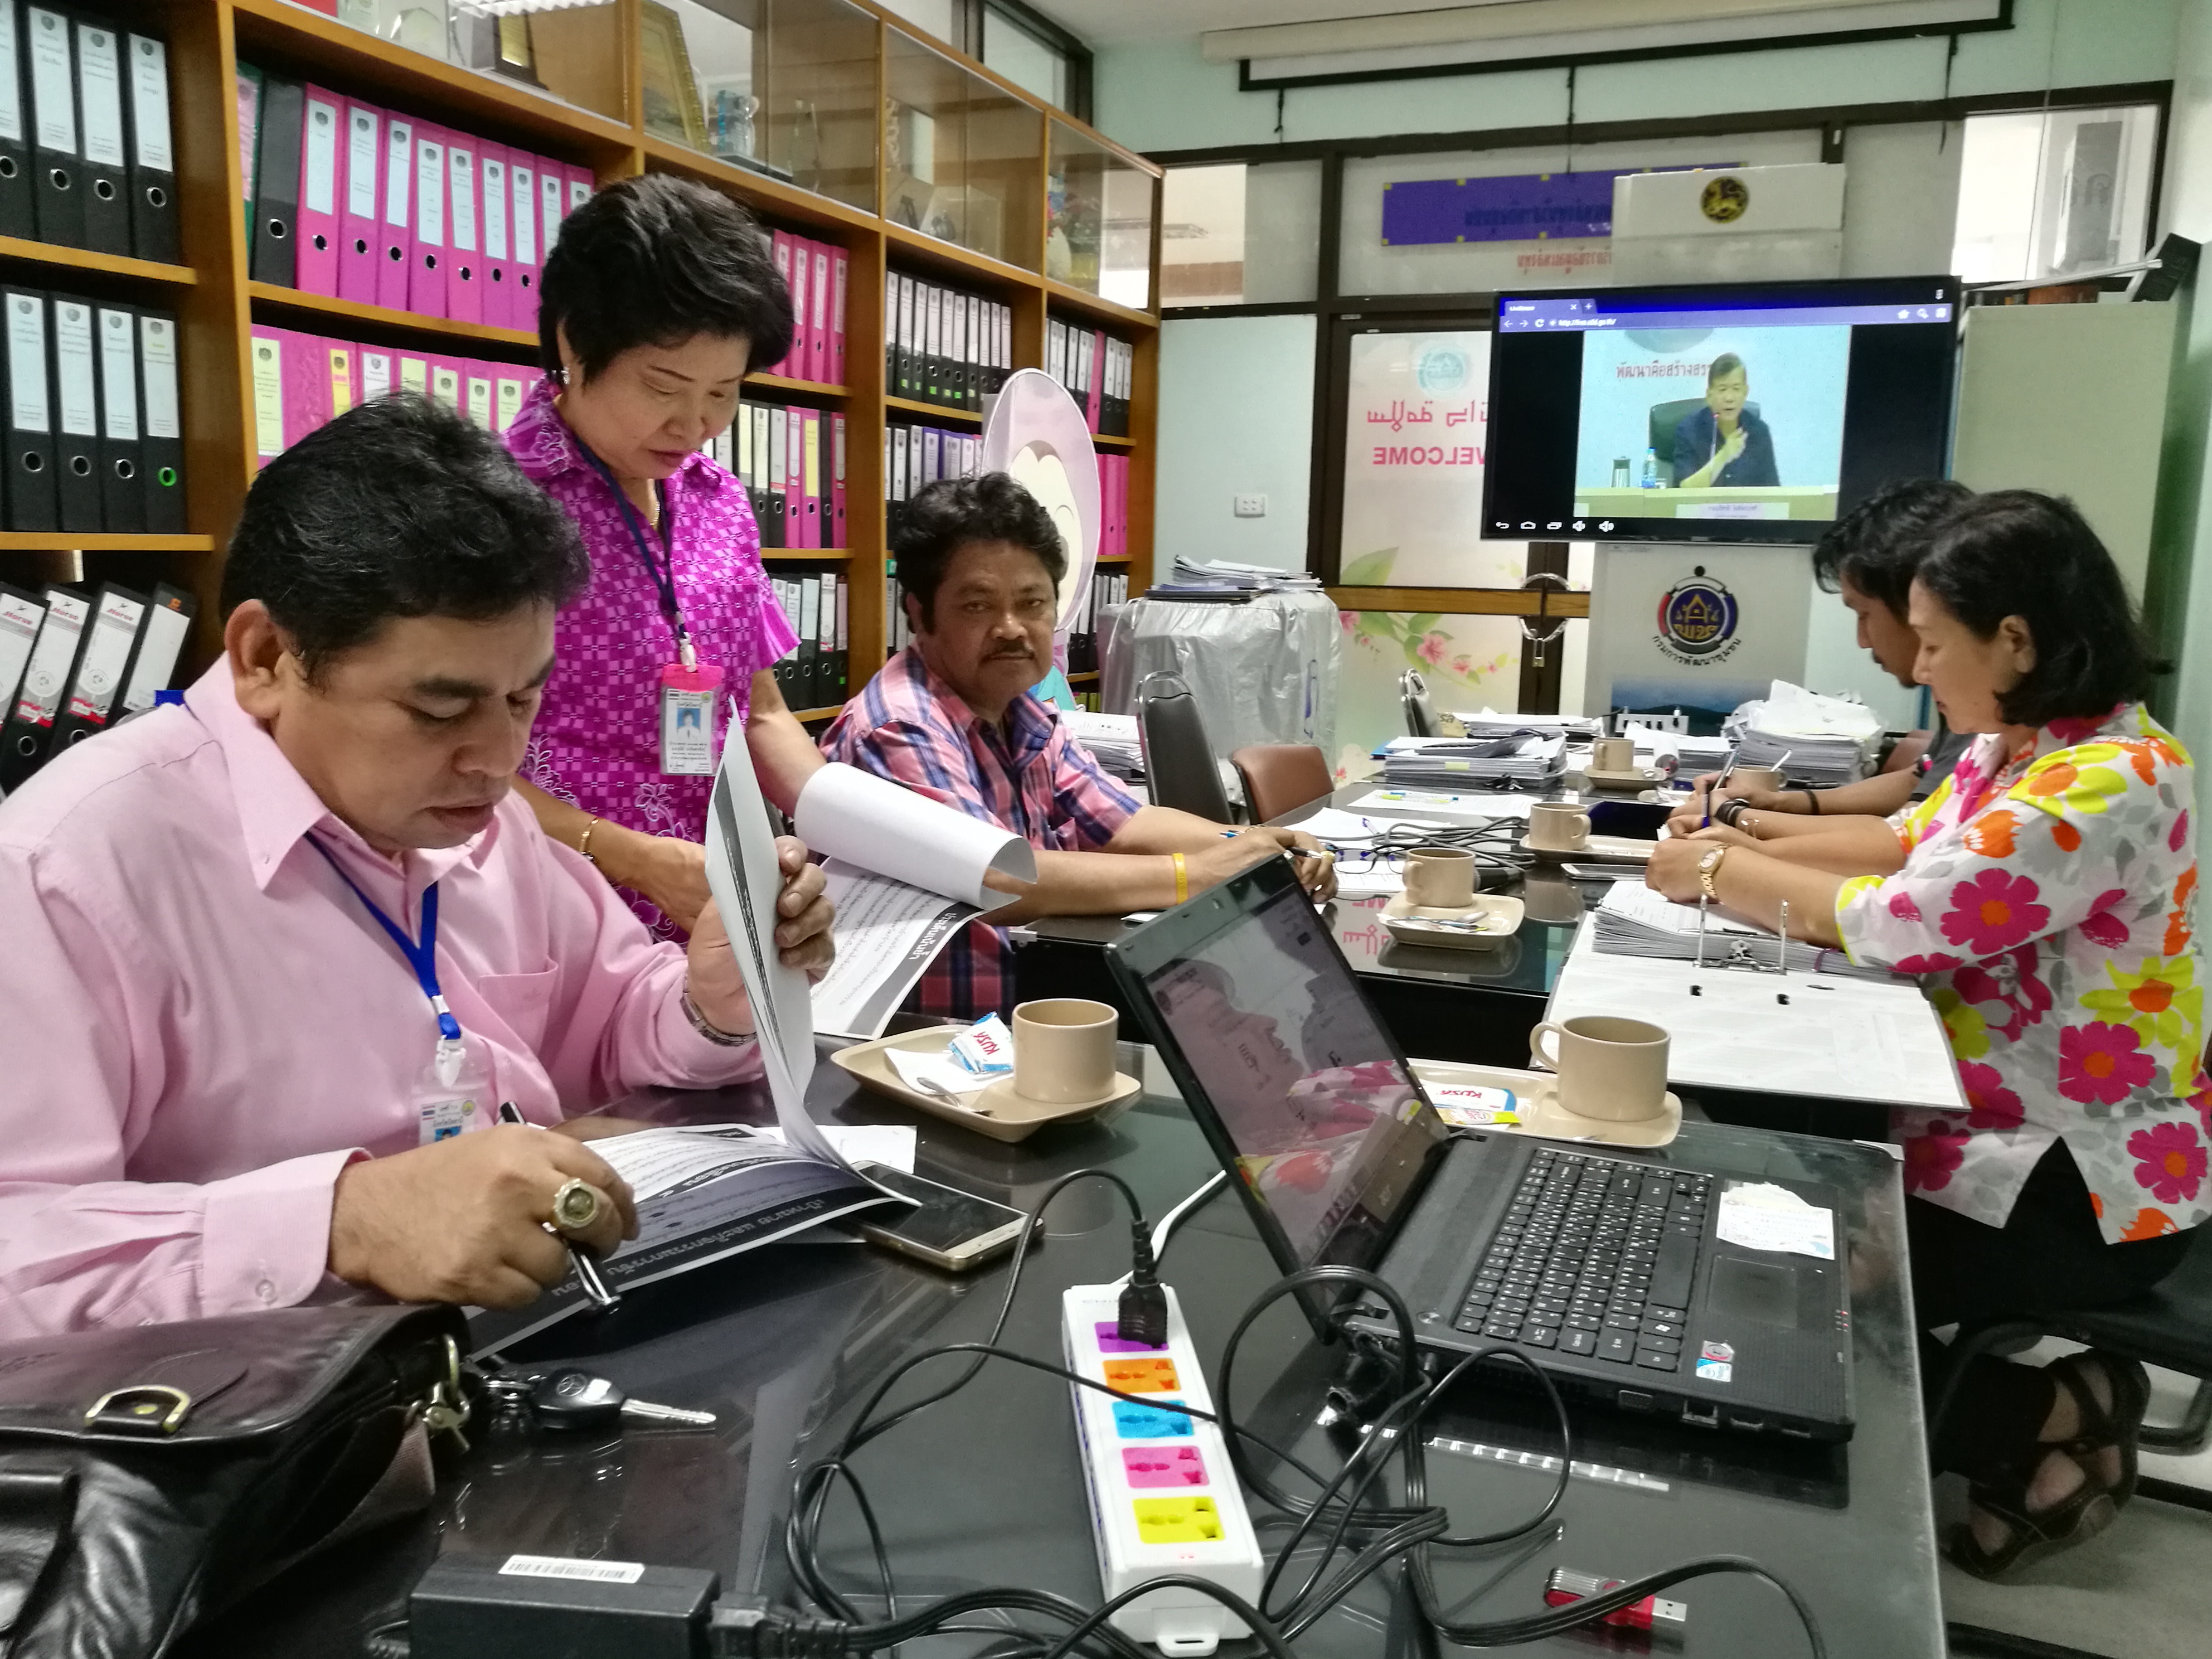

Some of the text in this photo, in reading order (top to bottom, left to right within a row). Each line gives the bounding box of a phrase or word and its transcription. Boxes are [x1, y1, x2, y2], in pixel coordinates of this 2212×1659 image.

[1616, 360, 1710, 379] พัฒนาคือสร้างสร
[1652, 636, 1742, 666] กรมการพัฒนาชุมชน
